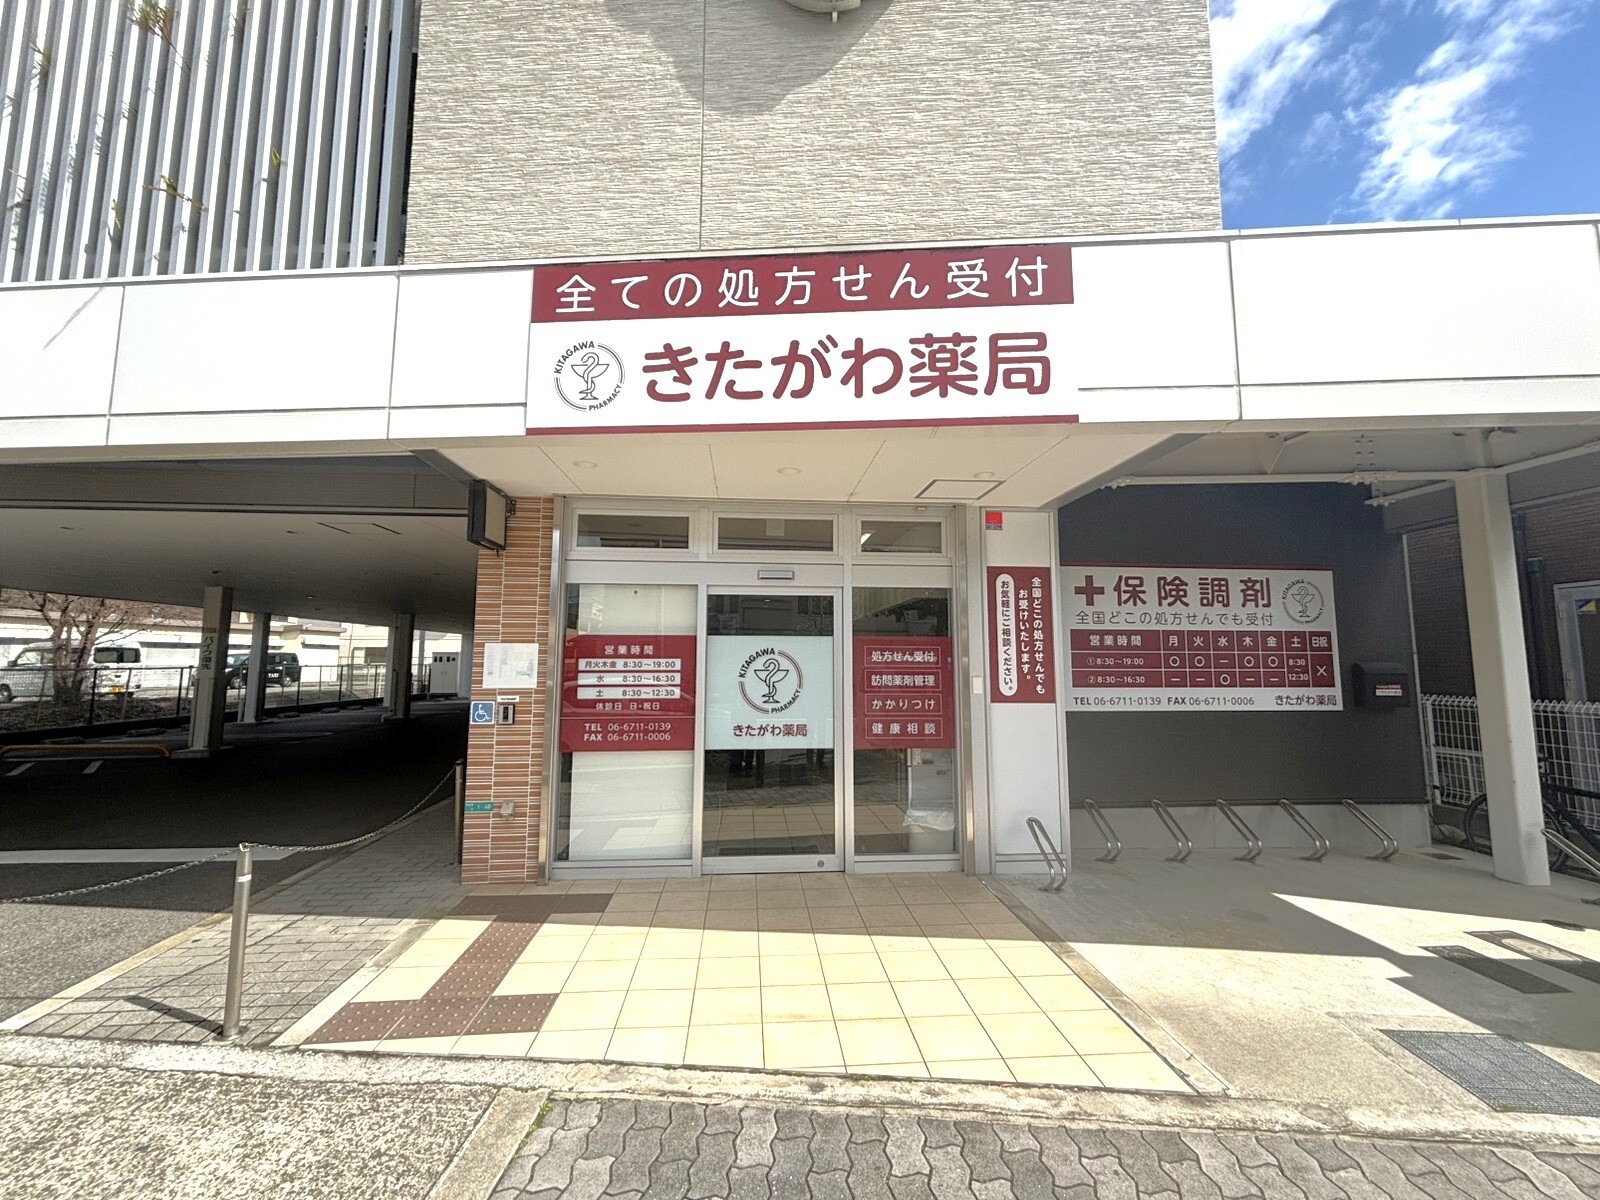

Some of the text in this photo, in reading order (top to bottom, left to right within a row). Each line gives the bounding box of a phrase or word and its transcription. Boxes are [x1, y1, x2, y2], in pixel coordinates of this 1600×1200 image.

[555, 256, 1049, 314] 全ての処方せん受付
[553, 340, 595, 375] KITAGAWA
[642, 331, 1051, 403] きたがわ薬局
[588, 383, 622, 412] PHARMACY
[1113, 575, 1272, 608] 保険調剤
[1075, 610, 1274, 627] 全国どこの処方せんでも受付
[1000, 579, 1013, 691] お気軽にご相談ください。
[1018, 588, 1031, 680] お受けいたします。
[1031, 576, 1045, 695] 全国どこの処方せんでも
[1089, 635, 1328, 648] 営業時間 月 火 水 木 金 土 日祝
[604, 645, 654, 655] 営業時間
[871, 650, 936, 662] 処方せん受付
[584, 660, 617, 669] 月火木金
[738, 647, 776, 679] KITAGAWA
[596, 674, 605, 683] 水
[871, 674, 936, 687] 訪問薬剤管理
[595, 689, 604, 697] 土
[770, 688, 802, 715] PHARMACY
[871, 698, 936, 710] かかりつけ
[1073, 697, 1255, 706] TEL 06-6711-0139 FAX 06-6711-0006
[1275, 694, 1337, 706] きたがわ薬局
[584, 723, 671, 731] TEL 06-6711-0139
[732, 723, 808, 737] きたがわ薬局
[871, 722, 936, 735] 健康相談
[583, 733, 671, 742] FAX 06-6711-0006
